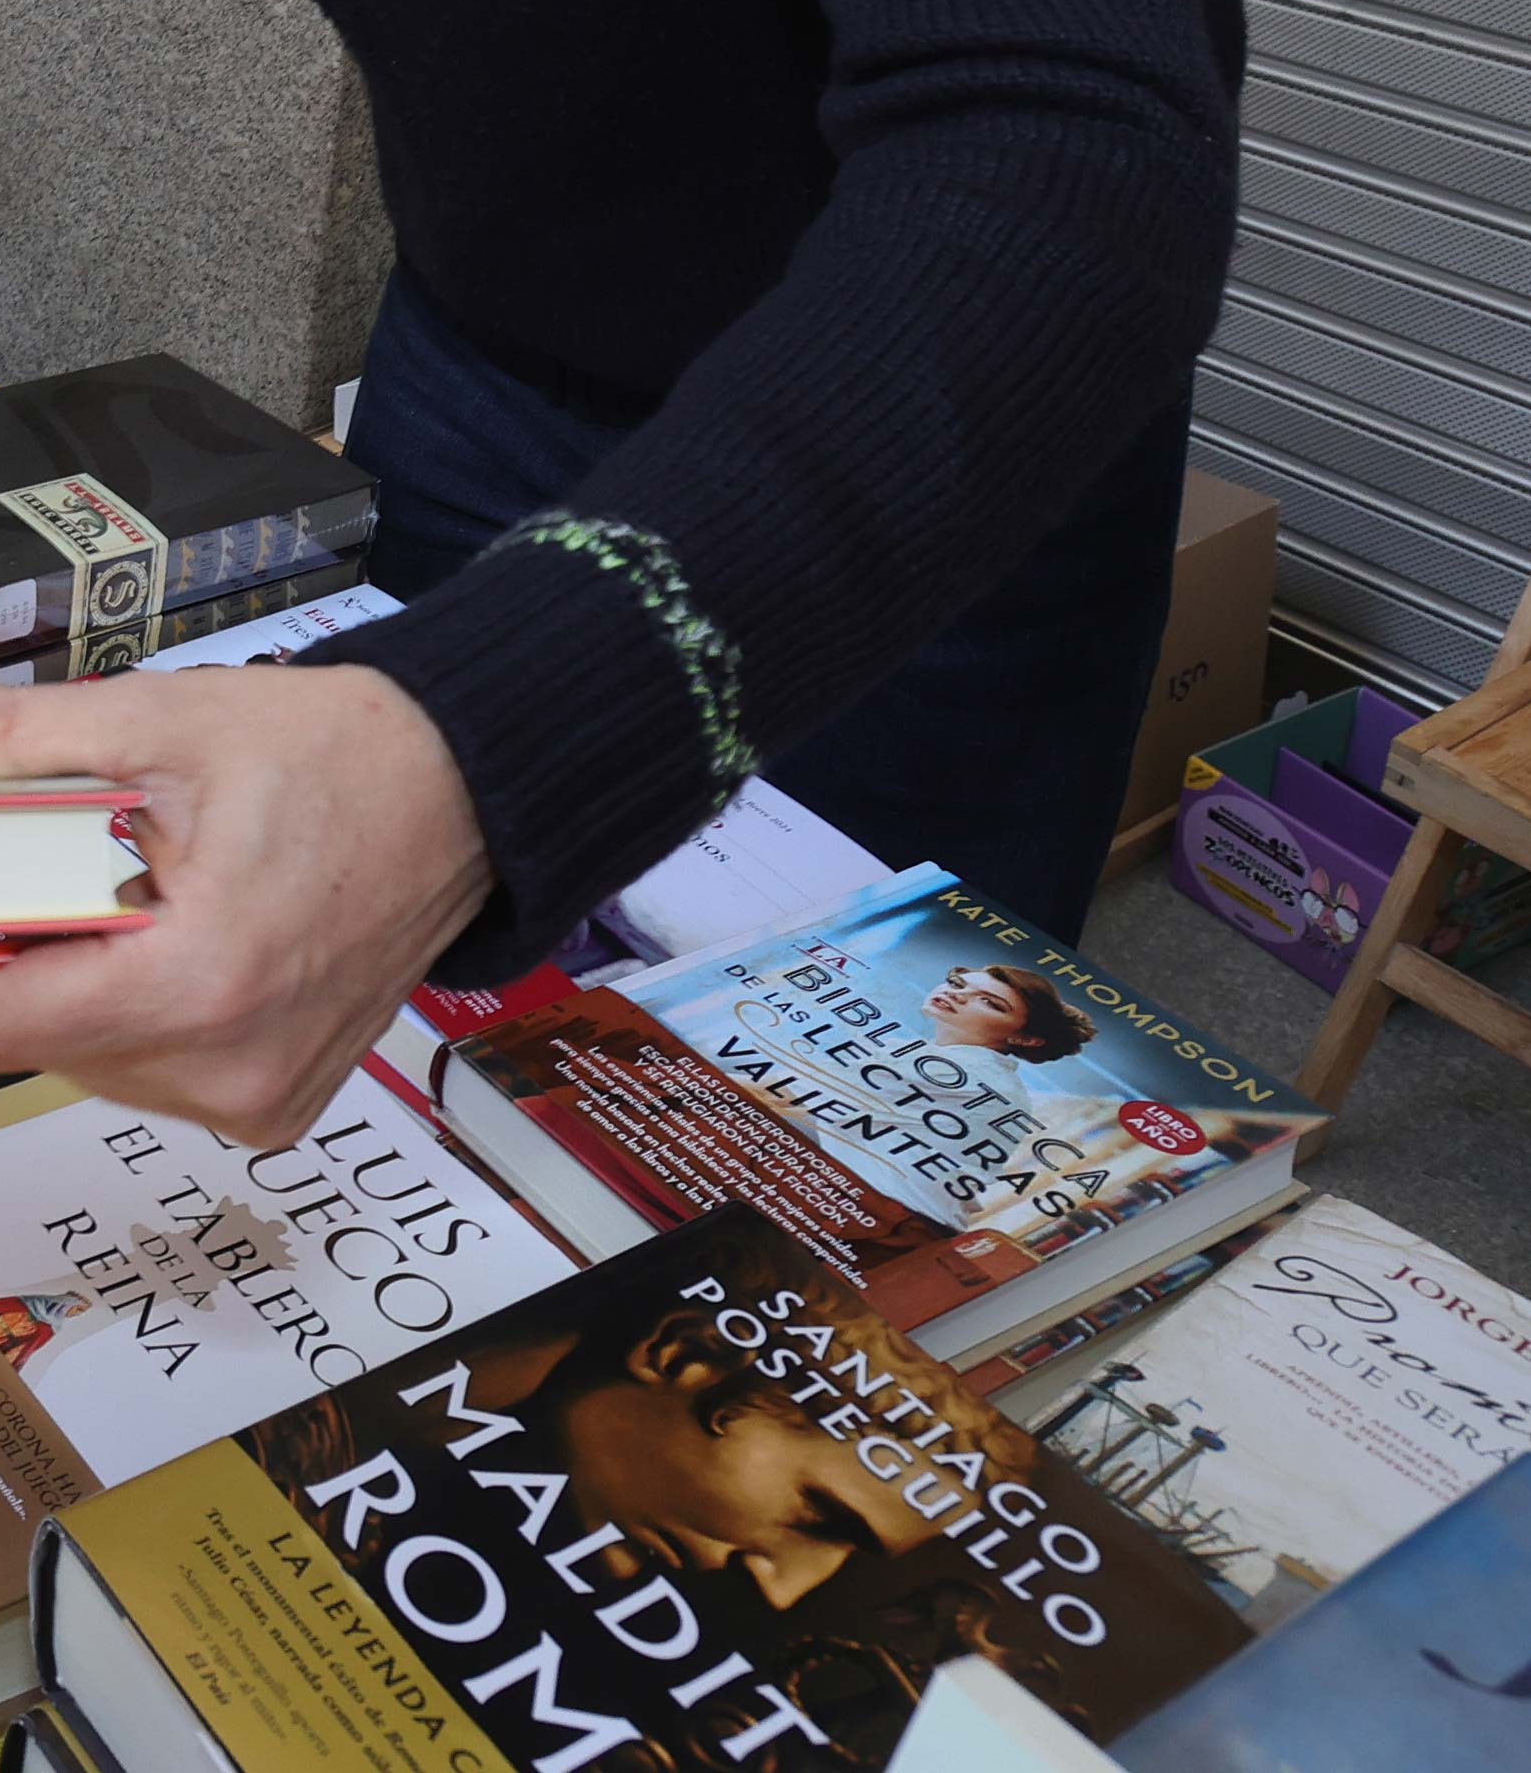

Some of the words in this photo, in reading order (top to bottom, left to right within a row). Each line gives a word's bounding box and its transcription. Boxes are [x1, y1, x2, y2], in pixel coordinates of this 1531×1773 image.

[280, 615, 316, 641] Tres
[805, 943, 857, 971] LA
[933, 889, 1032, 946] KATE
[1024, 948, 1279, 1104] THOMPSON
[630, 1058, 649, 1068] Y
[640, 1065, 665, 1081] SE
[656, 1078, 750, 1147] REFUGIARON
[741, 1144, 768, 1162] EN
[760, 1159, 789, 1178] LA
[636, 1045, 722, 1106] ESCAPARON
[713, 1102, 741, 1121] DE
[732, 1118, 771, 1144] UNA
[762, 1141, 807, 1173] DURA
[801, 1170, 879, 1228] REALIDAD
[675, 1056, 722, 1088] ELLAS
[713, 1085, 741, 1103] LO
[733, 1100, 808, 1153] HICIERON
[699, 1034, 993, 1204] VALIENTES
[721, 963, 767, 988] DE
[758, 991, 816, 1023] LAS
[800, 1023, 1079, 1220] LECTORAS
[779, 963, 1123, 1199] BIBLIOTECA
[1123, 1113, 1185, 1151] AÑO
[1144, 1105, 1201, 1140] LIBRO
[100, 1121, 151, 1179] EL
[143, 1174, 372, 1394] TABLERO
[135, 1234, 185, 1272] DE
[168, 1271, 216, 1309] LA
[306, 1116, 491, 1263] LUIS
[32, 1207, 217, 1383] REINA
[1288, 1321, 1400, 1390] QUE
[669, 1275, 1125, 1653] POSTEGUILLO
[751, 1285, 1118, 1581] SANTIAGO
[263, 1532, 324, 1579] LA
[299, 1582, 466, 1741] LEYENDA
